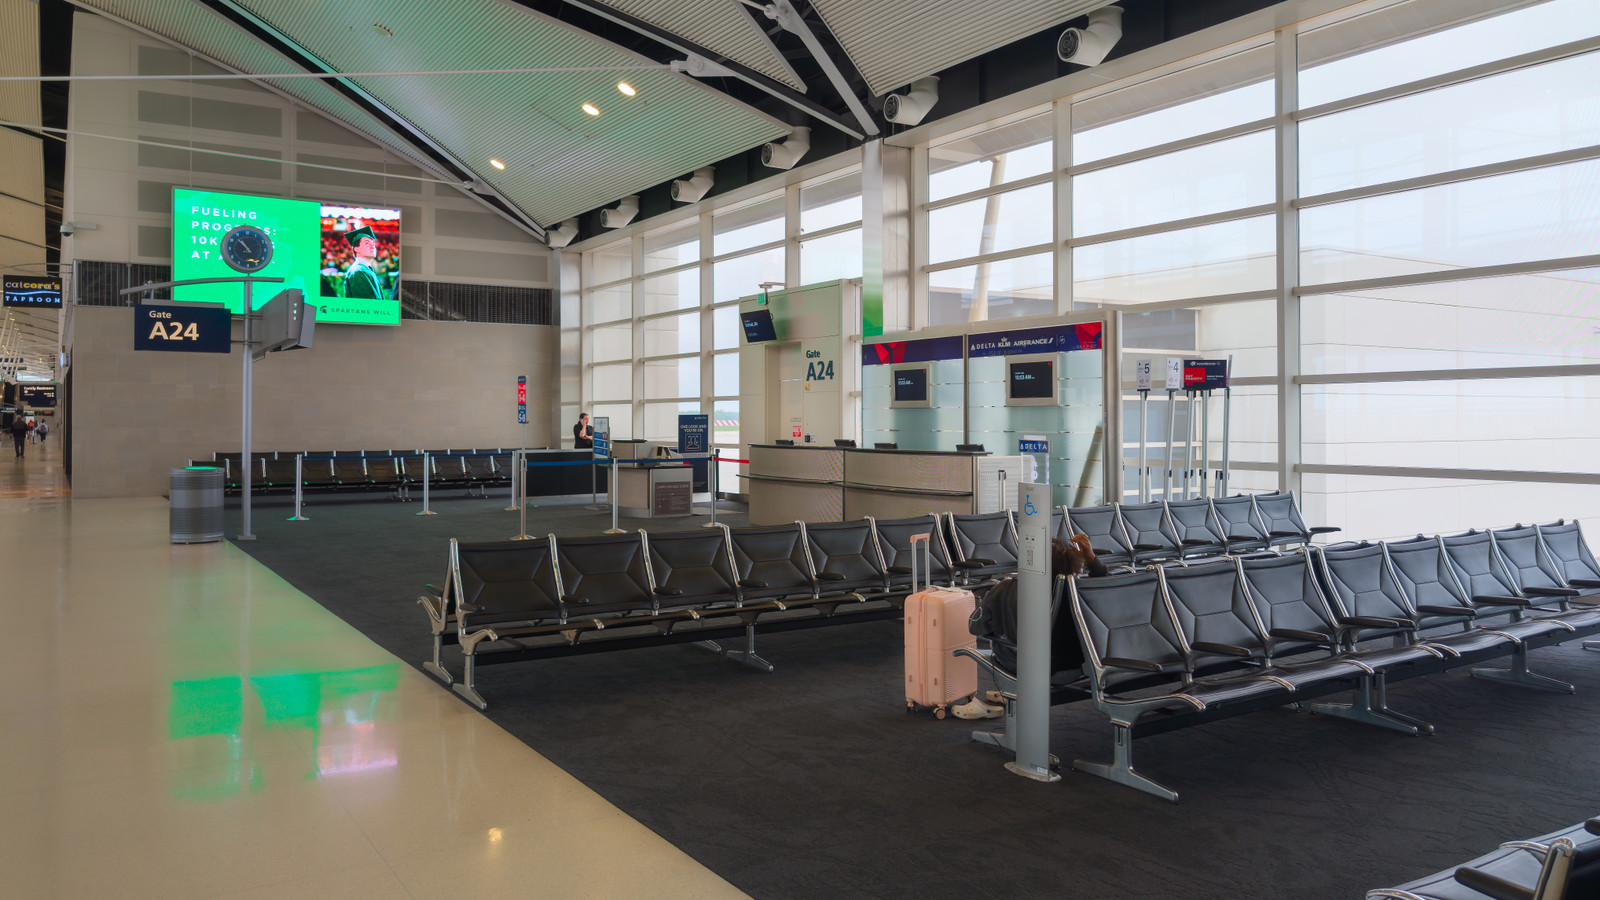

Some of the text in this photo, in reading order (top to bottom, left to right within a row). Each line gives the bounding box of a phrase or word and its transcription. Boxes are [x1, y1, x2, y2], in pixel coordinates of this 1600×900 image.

[191, 206, 258, 220] FUELING
[191, 220, 277, 236] PROGS:
[191, 236, 218, 246] 10K
[191, 250, 211, 260] AT
[5, 295, 61, 303] TAPROOM
[148, 310, 172, 319] Gate
[148, 321, 200, 341] A24
[806, 350, 821, 359] Gate
[806, 360, 835, 382] A24
[1144, 362, 1150, 374] 5
[1173, 361, 1179, 373] 4
[1024, 442, 1048, 450] DELTA
